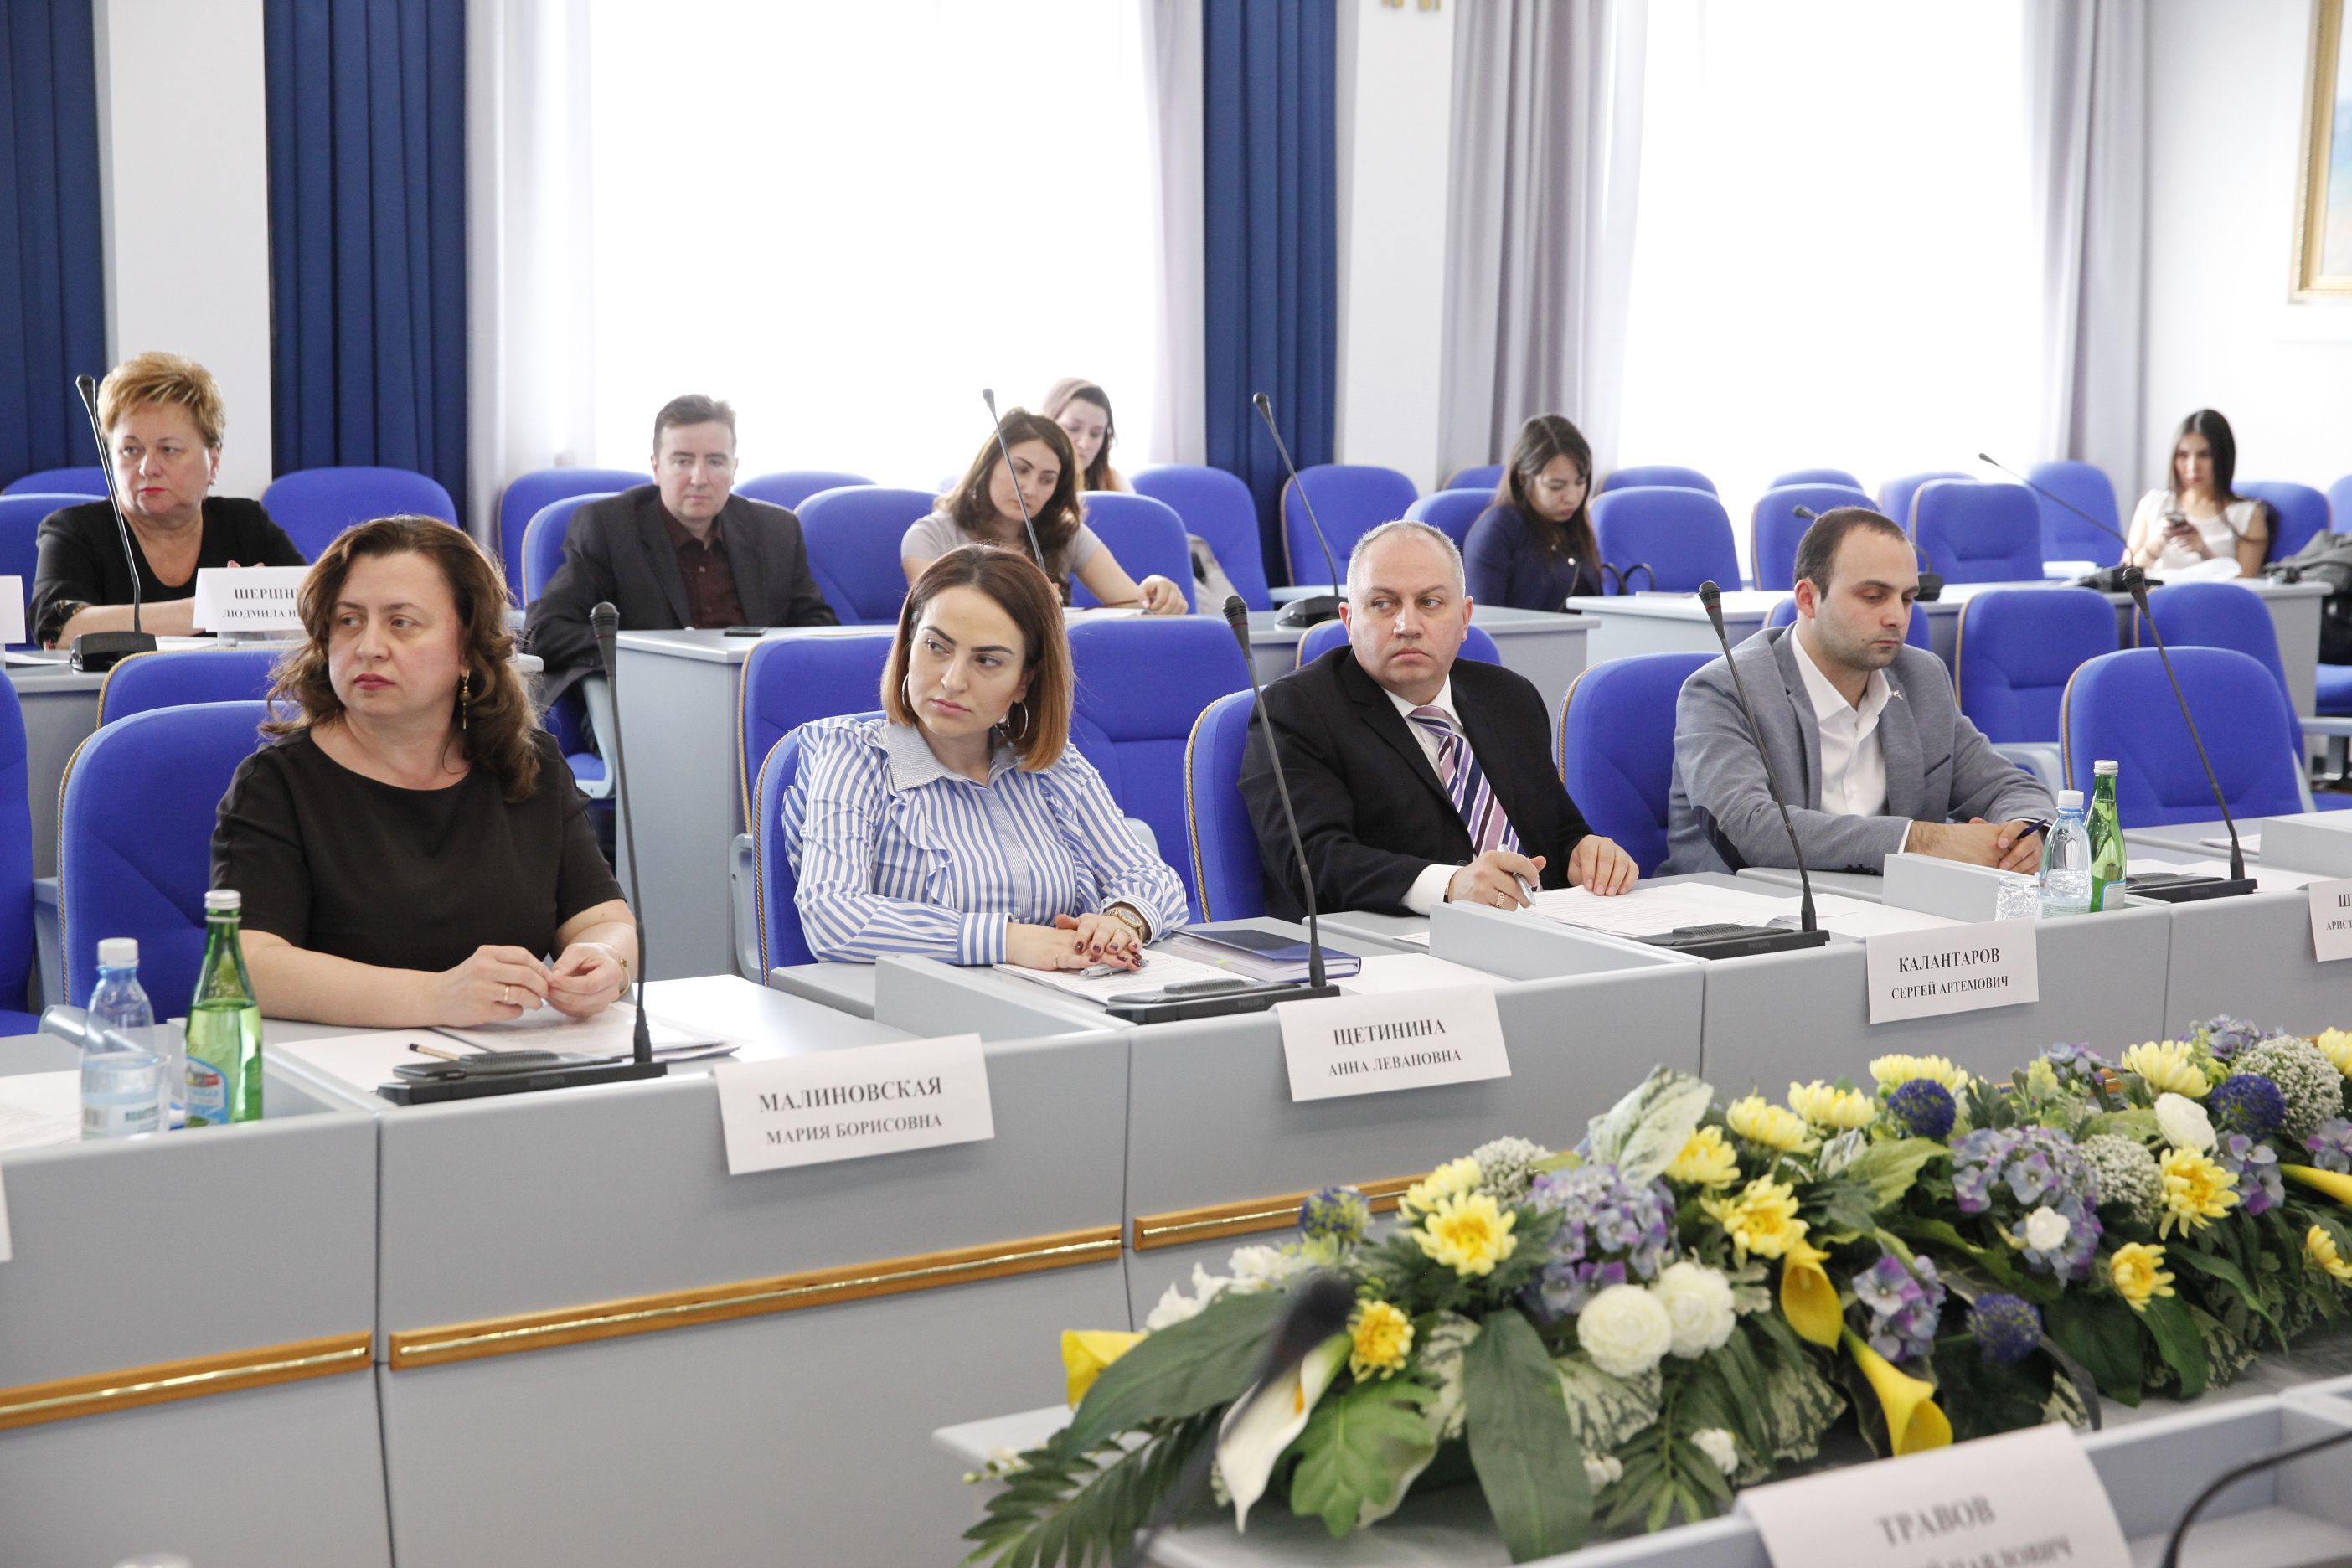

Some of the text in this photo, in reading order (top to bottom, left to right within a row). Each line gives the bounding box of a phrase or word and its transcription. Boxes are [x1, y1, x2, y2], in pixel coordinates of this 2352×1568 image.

[234, 588, 298, 600] ШЕРШН
[222, 609, 285, 619] ЛЮДМИЛА
[1898, 947, 2000, 972] КАЛАНТАРОВ
[1891, 975, 2009, 1000] СЕРГЕЙ АРТЕМОВИЧ
[1333, 1019, 1447, 1047] ЩЕТИНИНА
[1328, 1049, 1462, 1077] АННА ЛЕВАНОВНА
[758, 1076, 943, 1112] МАЛИНОВСКАЯ
[766, 1113, 943, 1146] МАРИЯ БОРИСОВНА
[1875, 1495, 1995, 1545] ТРАВОВ
